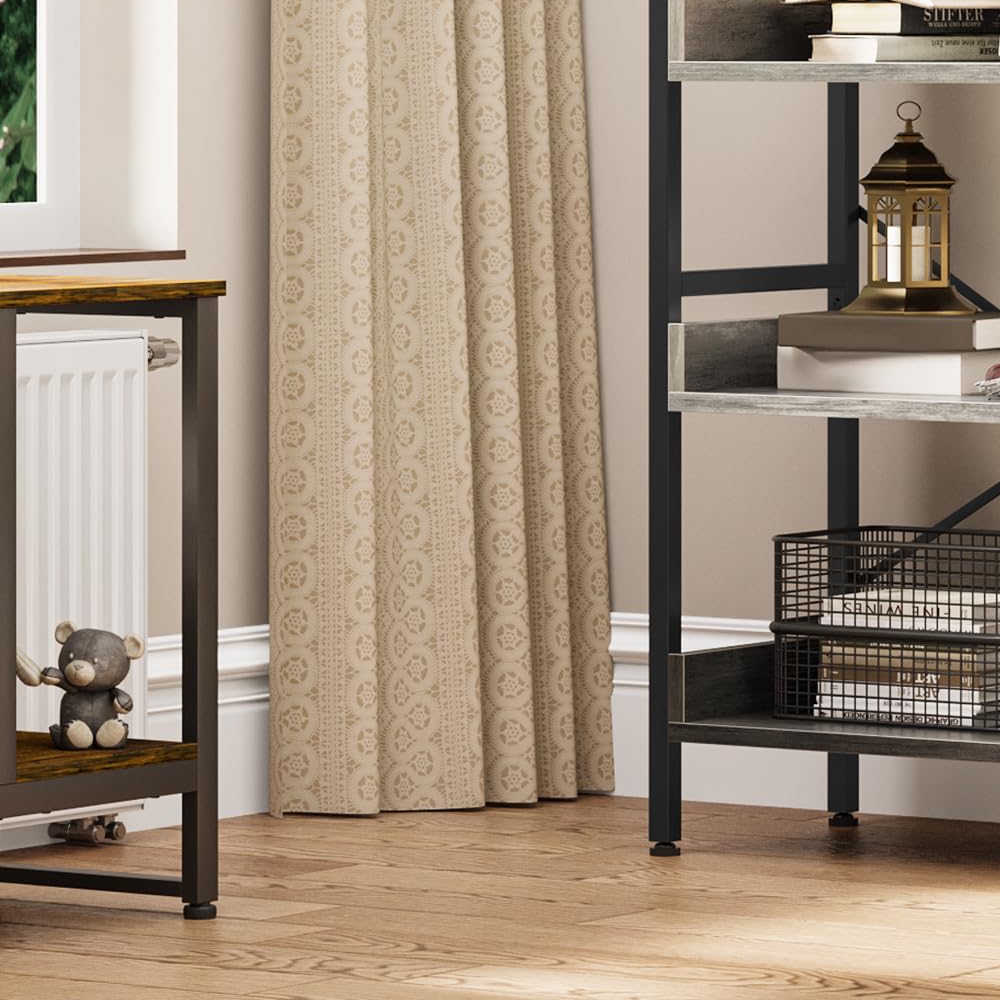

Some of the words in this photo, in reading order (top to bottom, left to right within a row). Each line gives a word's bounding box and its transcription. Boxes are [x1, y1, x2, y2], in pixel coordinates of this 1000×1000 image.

[923, 8, 984, 22] STIFTER
[980, 47, 998, 55] OSER
[843, 601, 904, 616] WINES
